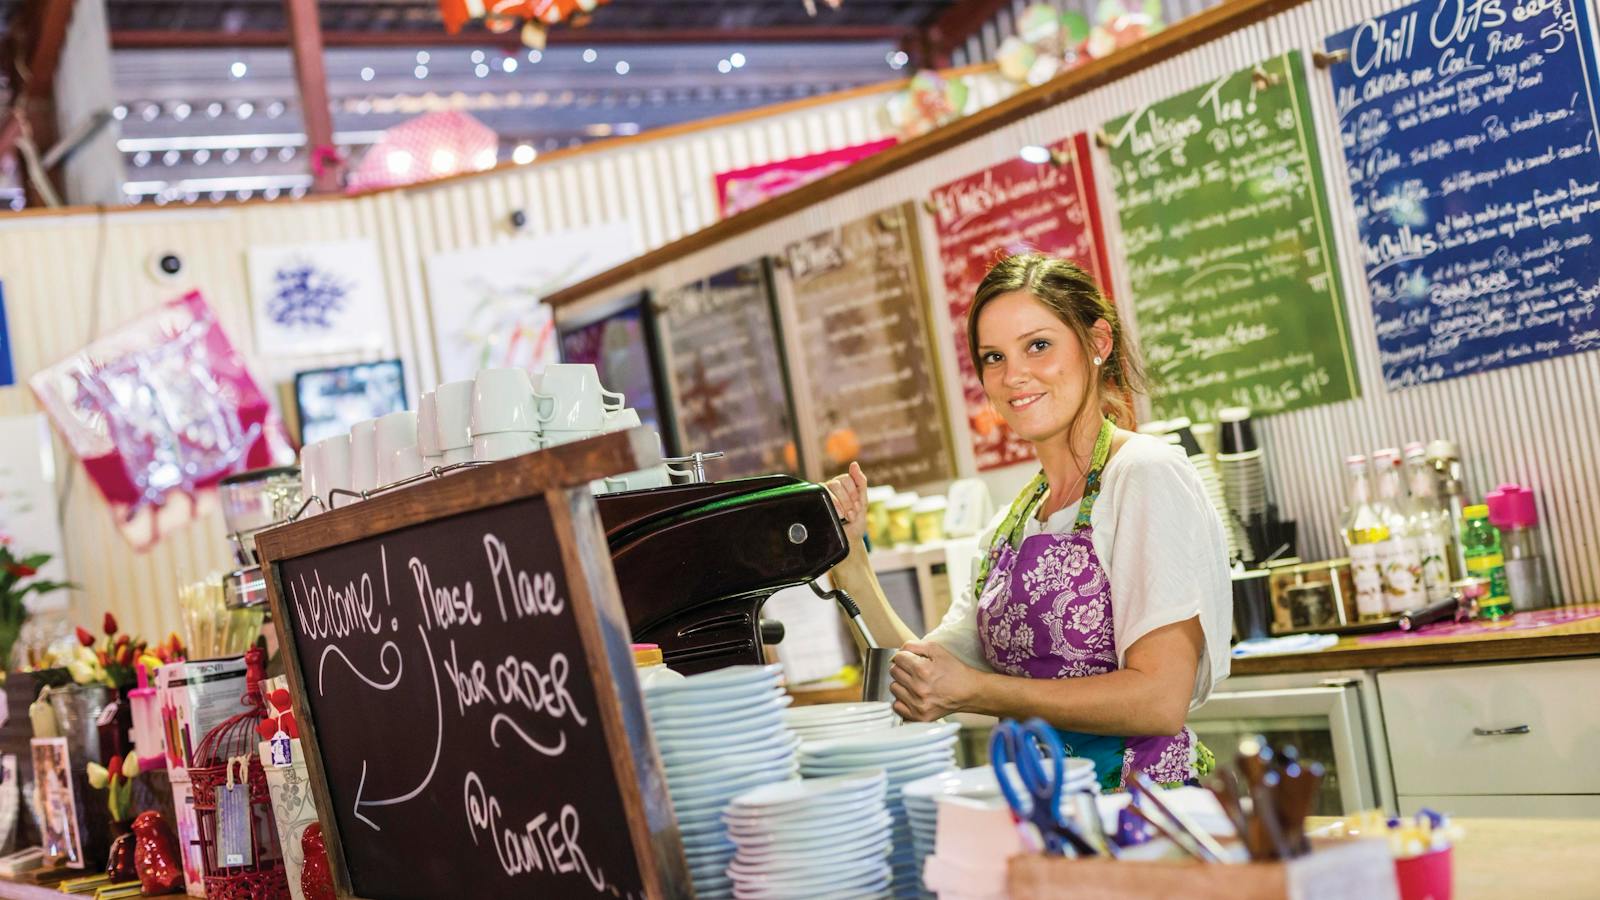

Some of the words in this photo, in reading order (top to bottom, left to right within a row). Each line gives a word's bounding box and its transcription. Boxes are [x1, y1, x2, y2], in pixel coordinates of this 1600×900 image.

[1351, 12, 1418, 77] Chill
[291, 543, 399, 641] Welcome!
[408, 556, 482, 630] Please
[483, 533, 564, 622] Place
[495, 652, 588, 726] ORDER
